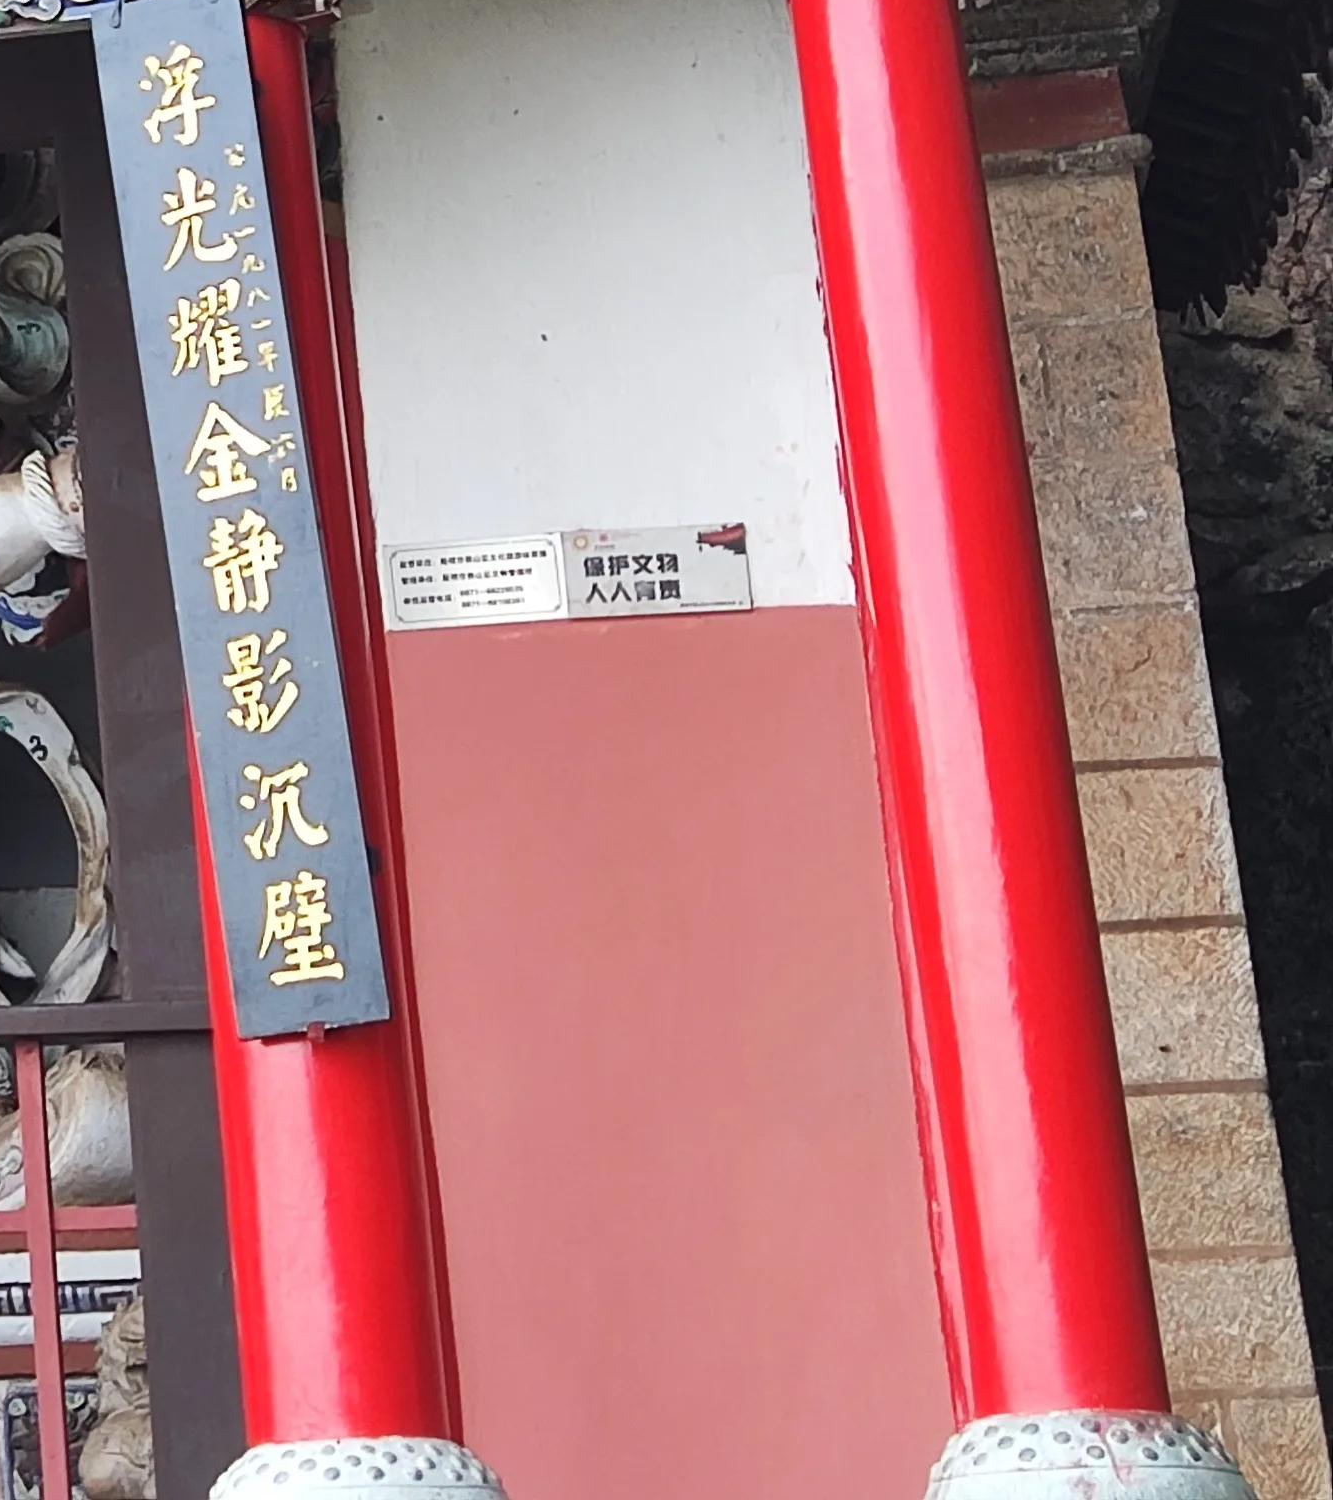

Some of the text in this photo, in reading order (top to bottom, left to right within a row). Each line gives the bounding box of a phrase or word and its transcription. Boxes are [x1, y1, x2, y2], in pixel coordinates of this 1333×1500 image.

[584, 553, 679, 577] 保护文物
[586, 580, 681, 603] 人人有责
